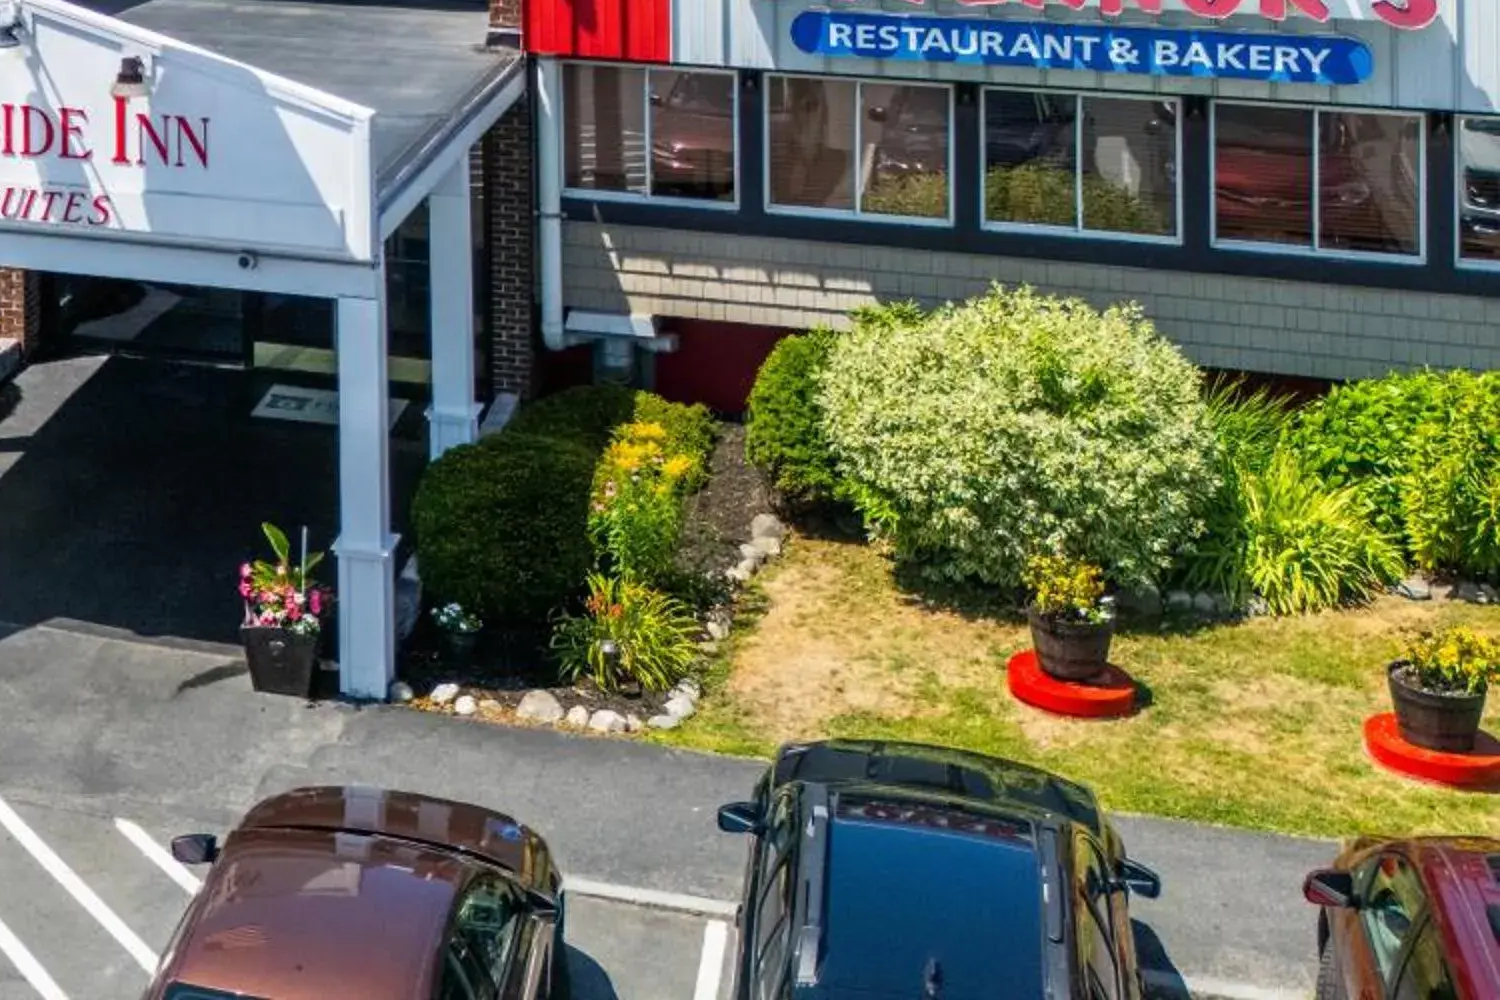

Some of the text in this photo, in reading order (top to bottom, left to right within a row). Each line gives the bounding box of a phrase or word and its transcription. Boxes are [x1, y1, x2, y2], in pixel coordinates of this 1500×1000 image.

[828, 22, 1331, 73] RESTAURANT & BAKERY
[112, 95, 211, 169] INN
